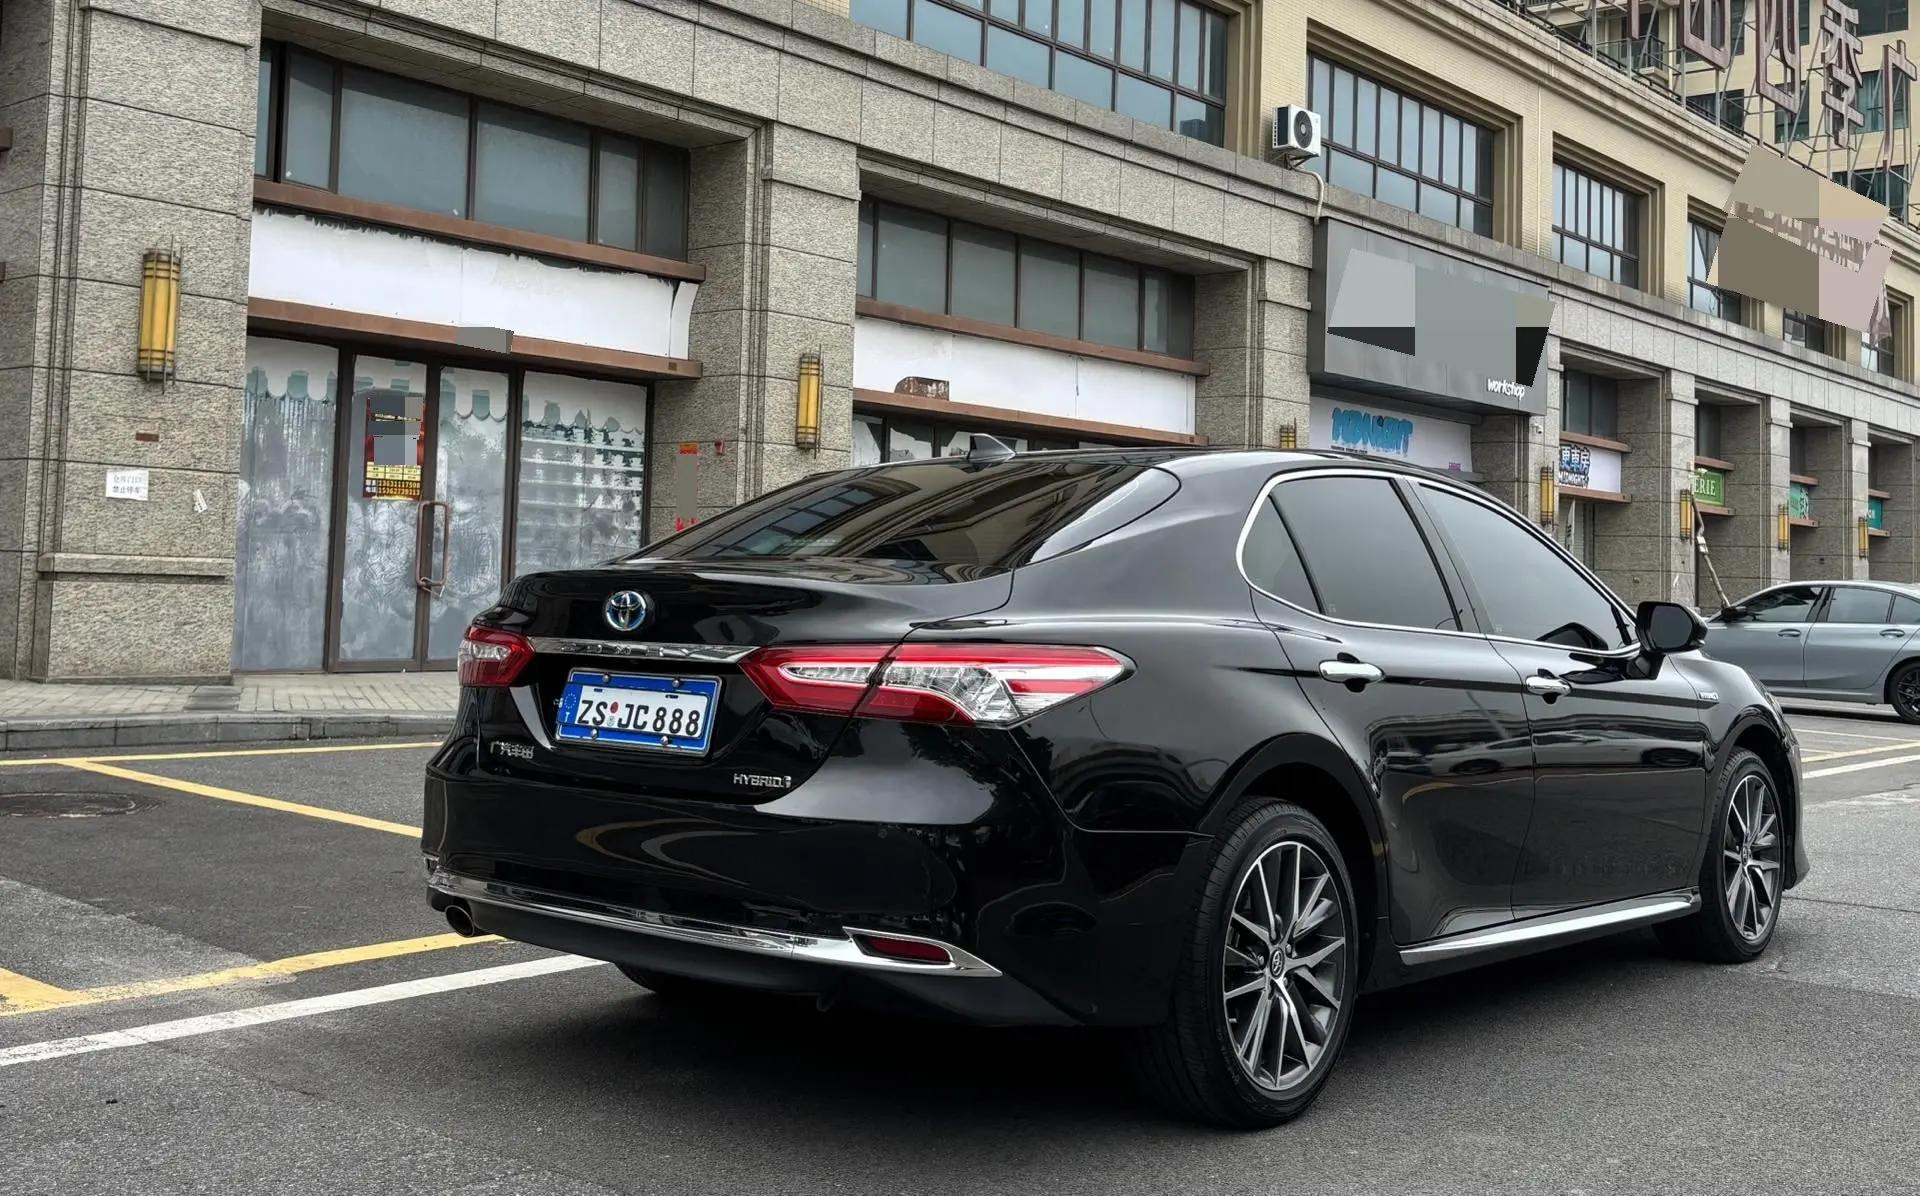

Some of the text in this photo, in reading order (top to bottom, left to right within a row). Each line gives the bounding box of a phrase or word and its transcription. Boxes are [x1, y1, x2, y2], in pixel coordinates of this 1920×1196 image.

[1487, 378, 1525, 400] workshop
[577, 699, 608, 726] ZS
[733, 772, 784, 788] HYBRID
